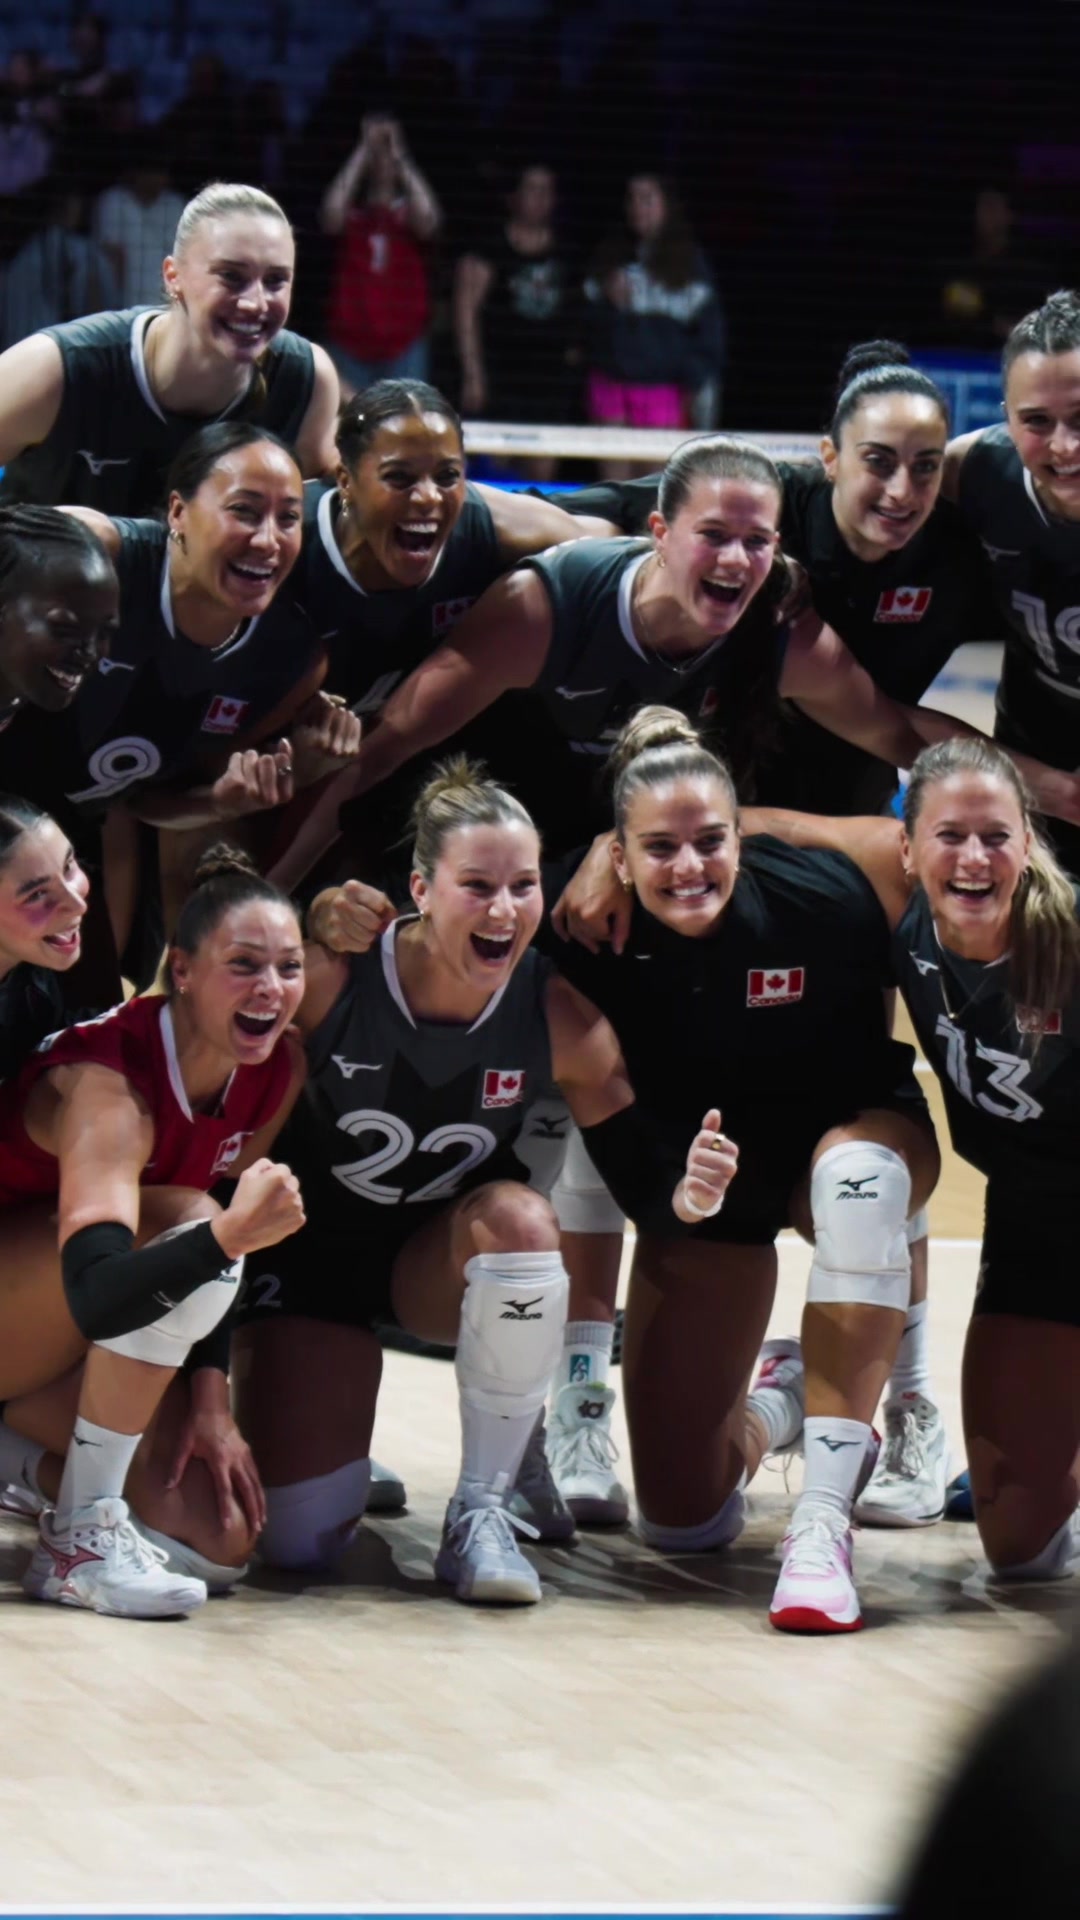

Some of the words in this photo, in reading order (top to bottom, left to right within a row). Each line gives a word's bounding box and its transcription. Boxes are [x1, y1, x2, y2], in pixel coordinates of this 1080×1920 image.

[64, 736, 162, 804] 9
[748, 994, 801, 1006] Canada
[484, 1093, 524, 1107] Cana
[935, 1012, 1044, 1123] 13
[331, 1109, 498, 1206] 22
